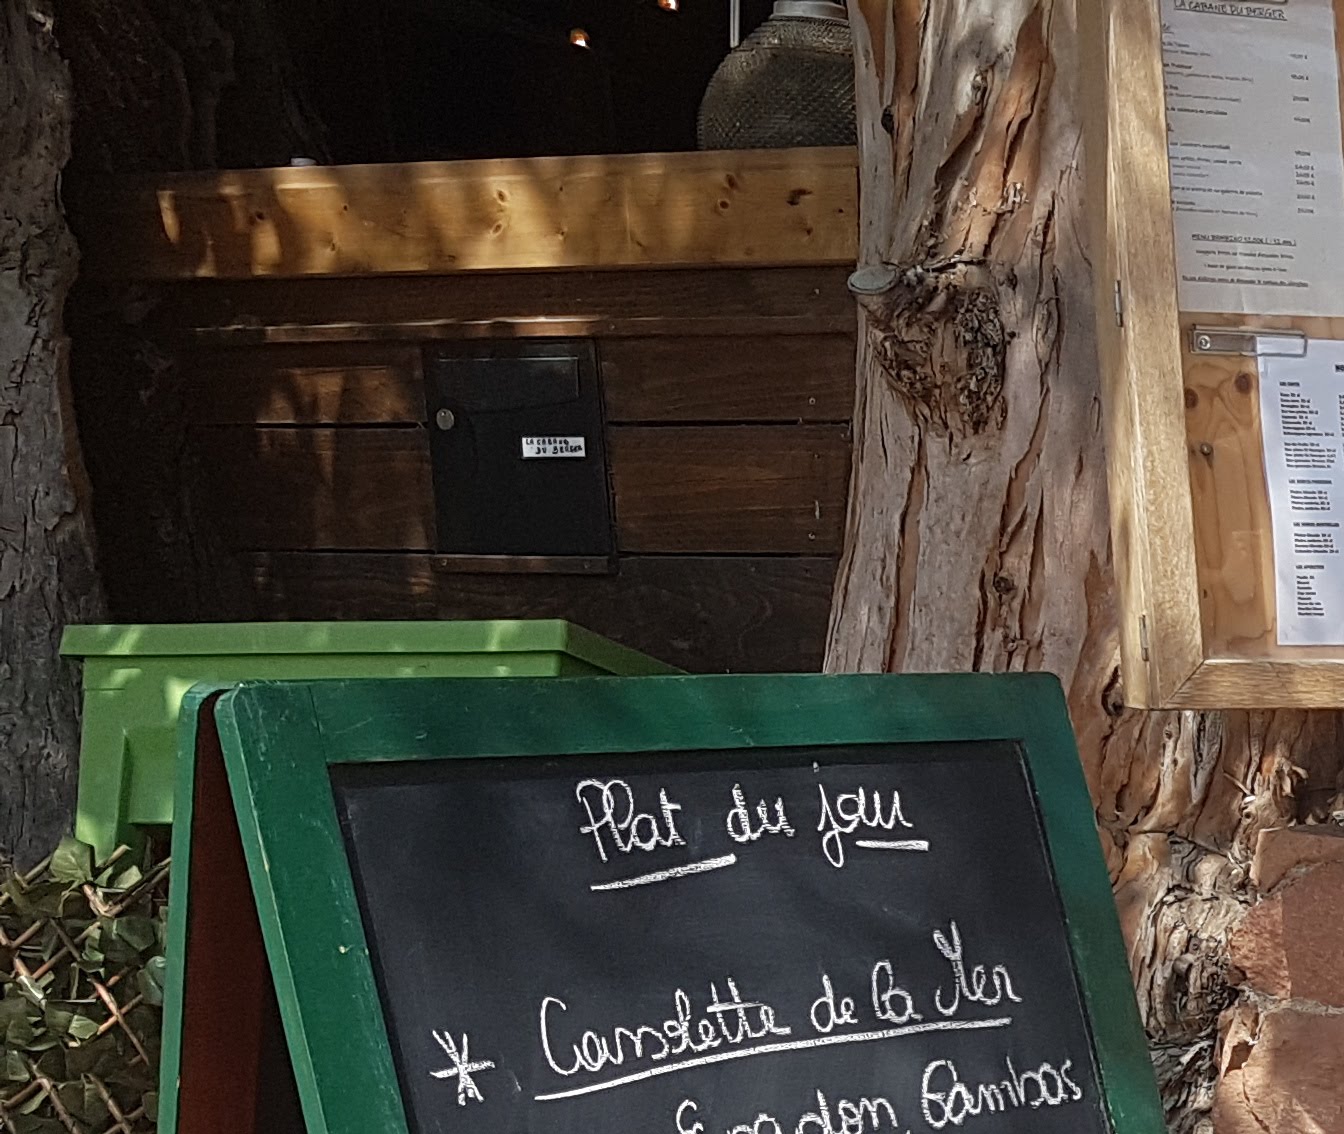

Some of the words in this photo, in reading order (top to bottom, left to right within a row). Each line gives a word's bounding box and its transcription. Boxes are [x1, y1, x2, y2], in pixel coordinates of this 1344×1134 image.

[576, 779, 686, 862] Plat
[727, 784, 795, 842] du
[811, 973, 858, 1034] de
